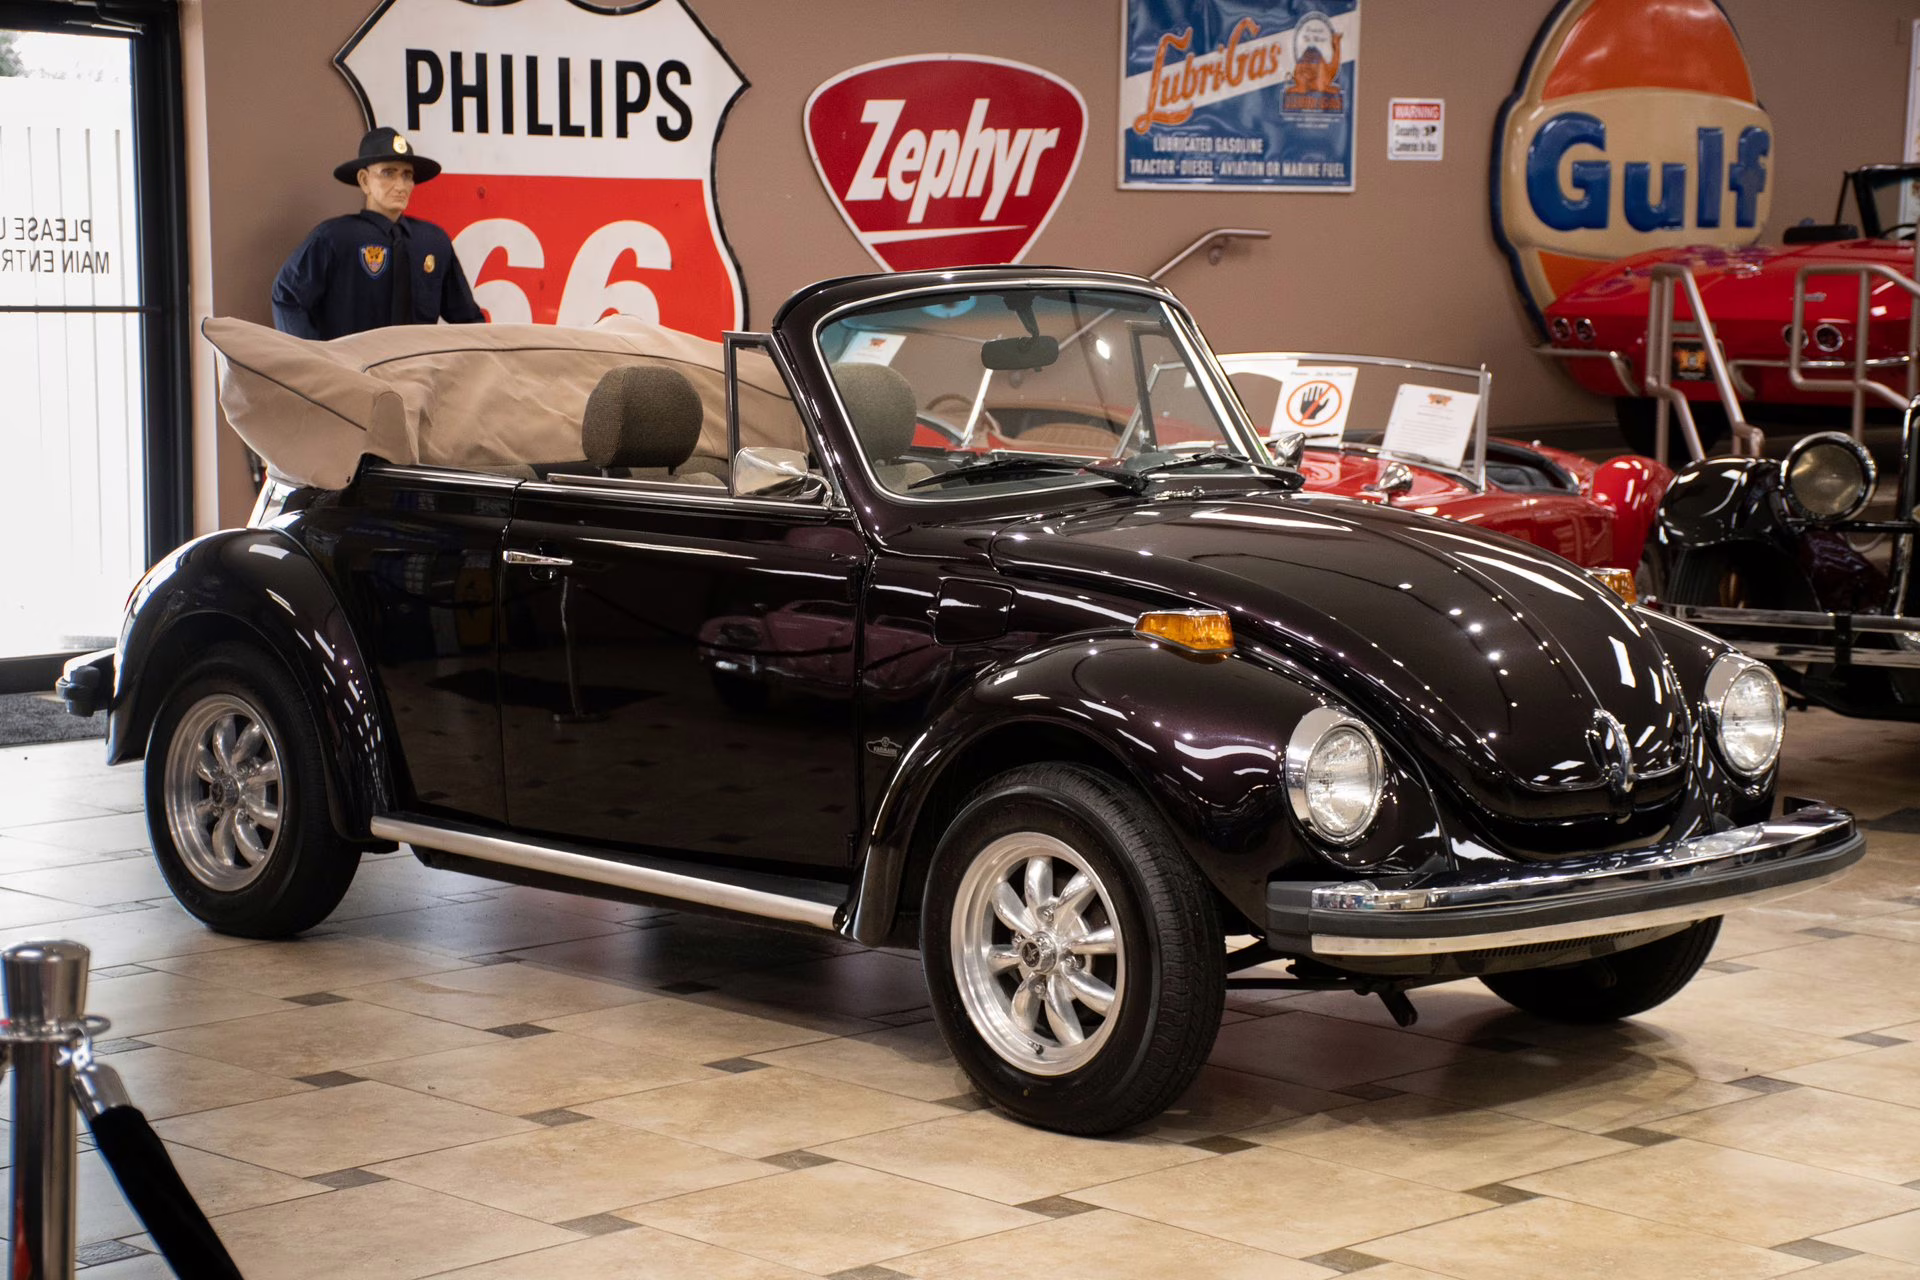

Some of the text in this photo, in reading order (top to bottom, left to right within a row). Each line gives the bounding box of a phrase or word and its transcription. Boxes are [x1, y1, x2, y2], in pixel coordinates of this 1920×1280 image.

[405, 48, 693, 142] PHILLIPS
[1395, 105, 1440, 119] WARNING
[844, 98, 1061, 224] Zephyr
[1130, 159, 1346, 178] TRACTOR DIESEL AVIATION OR MARINE FUEL
[1153, 136, 1264, 153] LUBRICATED GASOLINE
[1526, 111, 1771, 232] Gulf
[440, 218, 672, 325] 66
